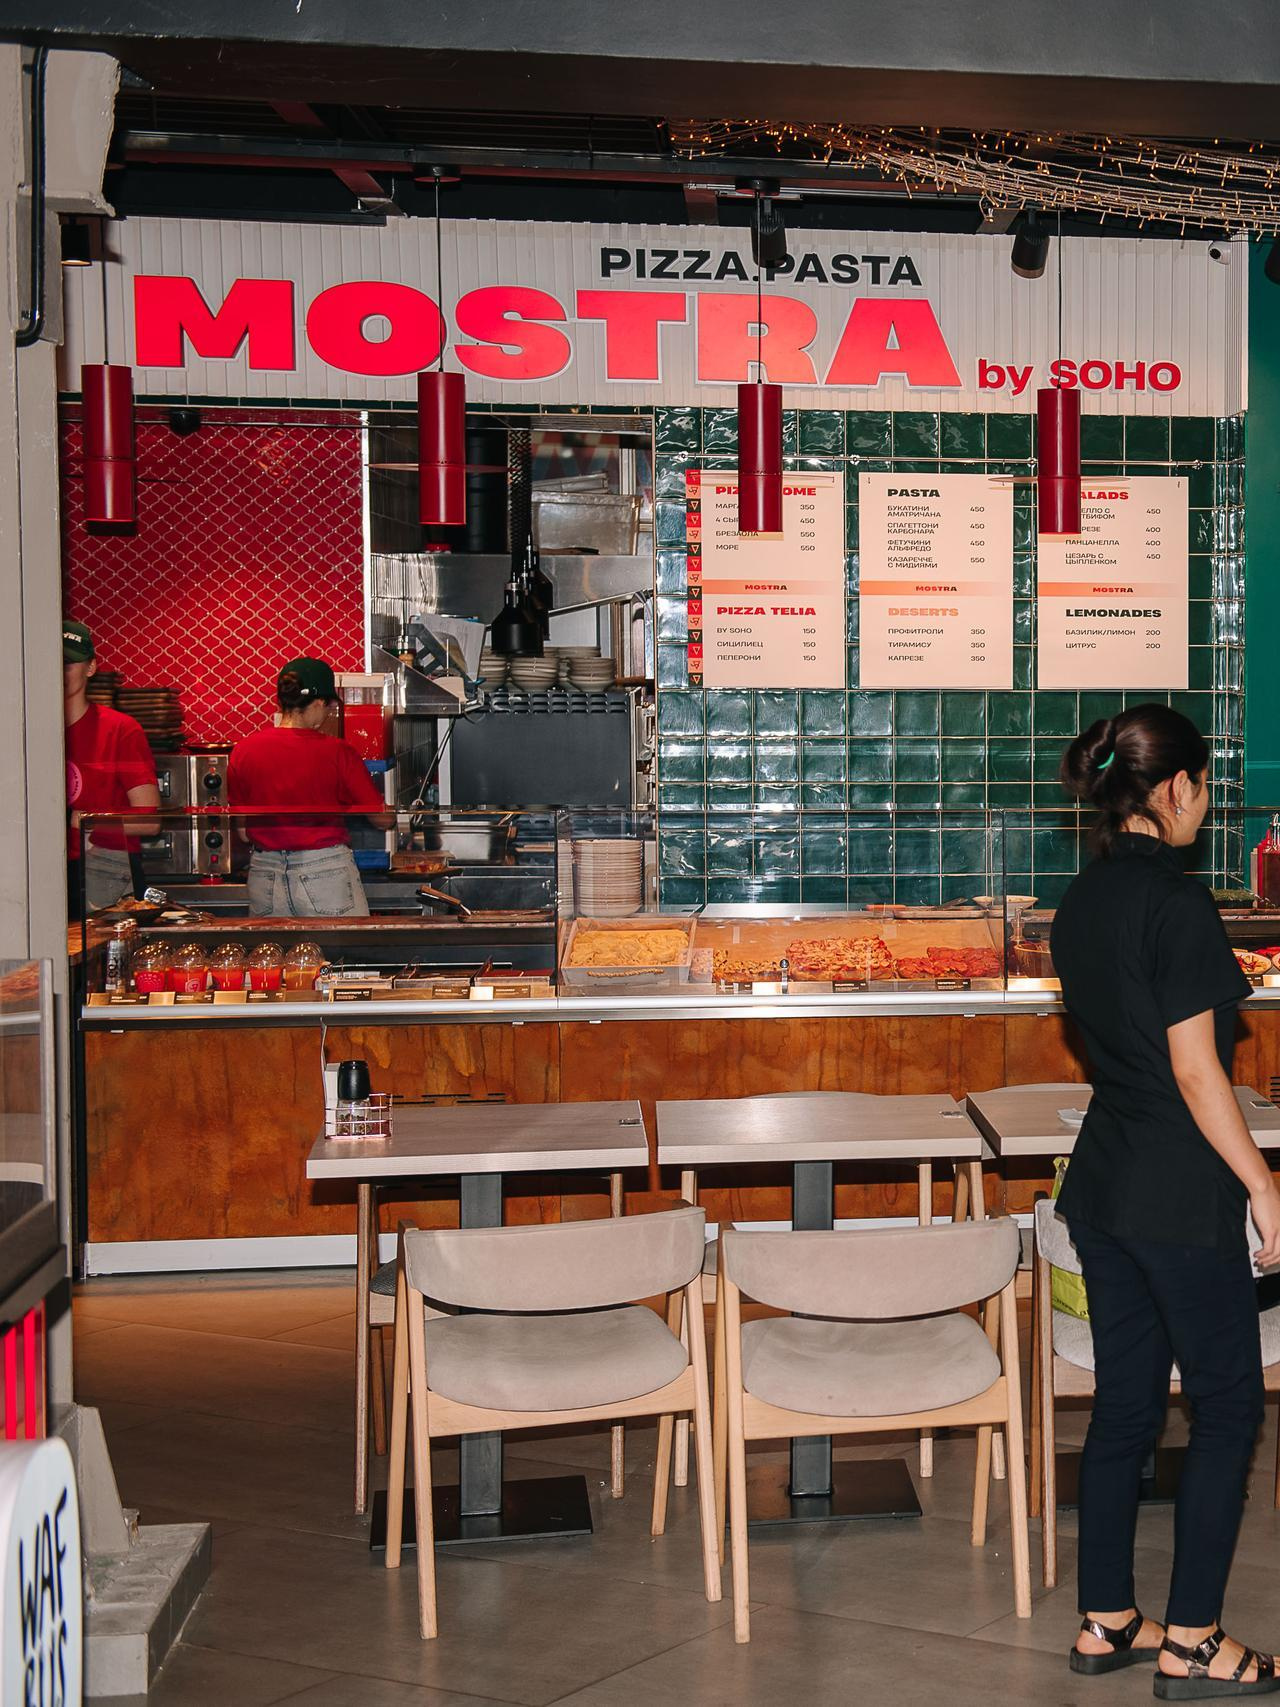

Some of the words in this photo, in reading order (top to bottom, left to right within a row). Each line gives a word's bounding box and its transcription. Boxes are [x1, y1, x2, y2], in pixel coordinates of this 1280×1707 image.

[134, 274, 962, 388] MOSTRA
[978, 358, 1034, 396] by
[1050, 358, 1182, 392] SOHO
[715, 486, 738, 495] PIZ
[783, 487, 816, 496] OME
[887, 488, 941, 498] PASTA
[1080, 491, 1129, 500] ALADS
[717, 606, 766, 616] PIZZA
[770, 607, 816, 616] TELIA
[888, 607, 959, 617] DESERTS
[1065, 609, 1162, 618] LEMONADES
[18, 1486, 68, 1660] WAF
